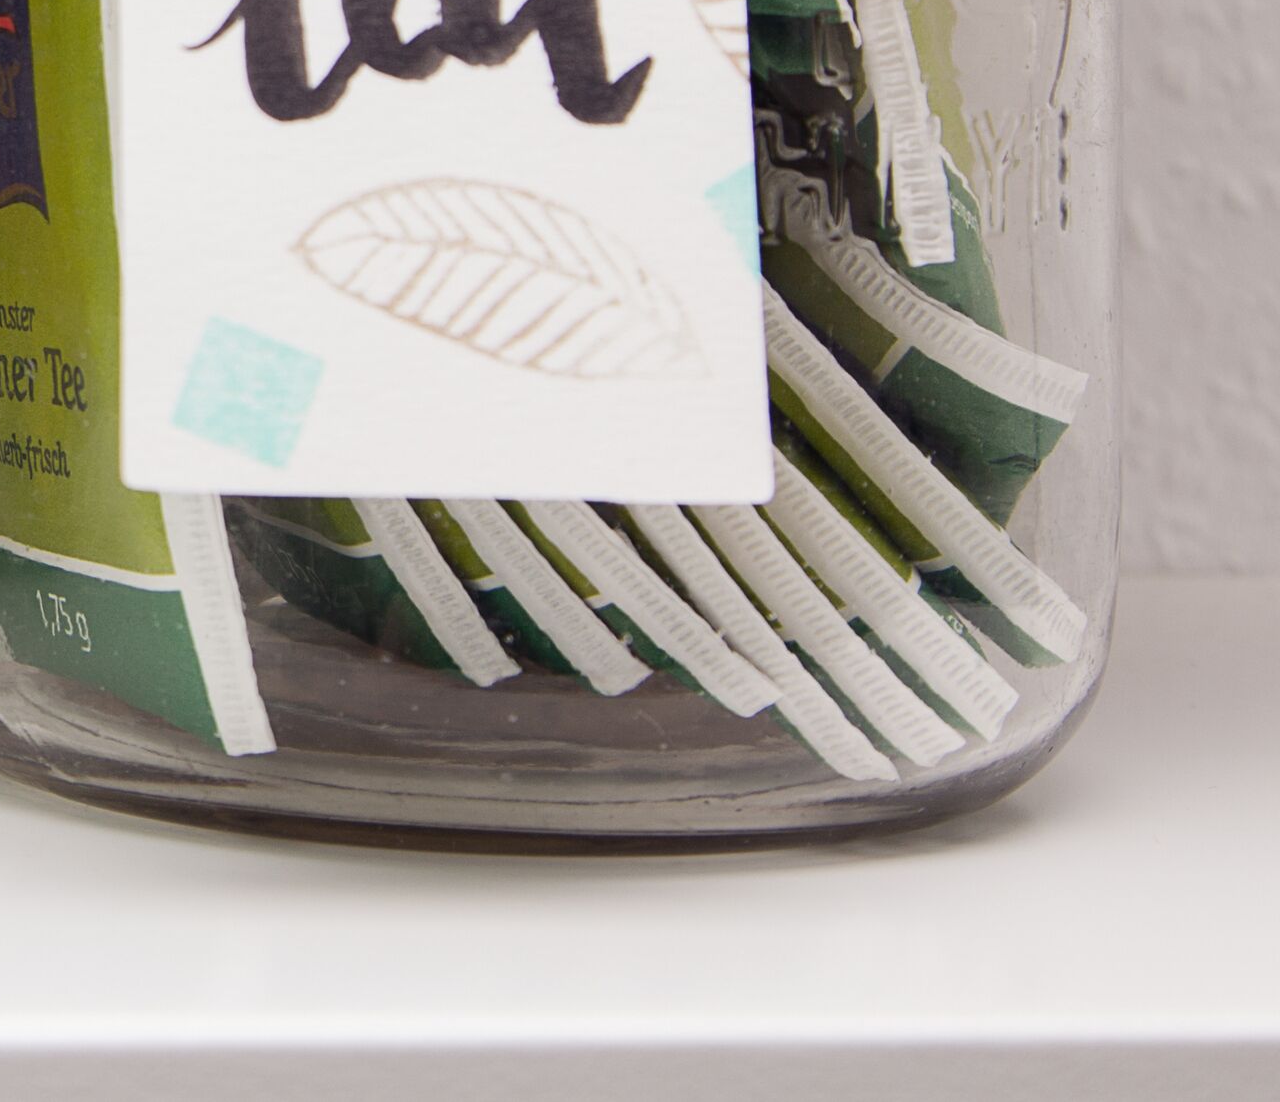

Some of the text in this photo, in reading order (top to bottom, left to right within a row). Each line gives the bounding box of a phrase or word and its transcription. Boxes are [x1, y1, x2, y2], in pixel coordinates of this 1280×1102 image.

[43, 346, 88, 411] Tee
[36, 589, 91, 652] 1,75 g
